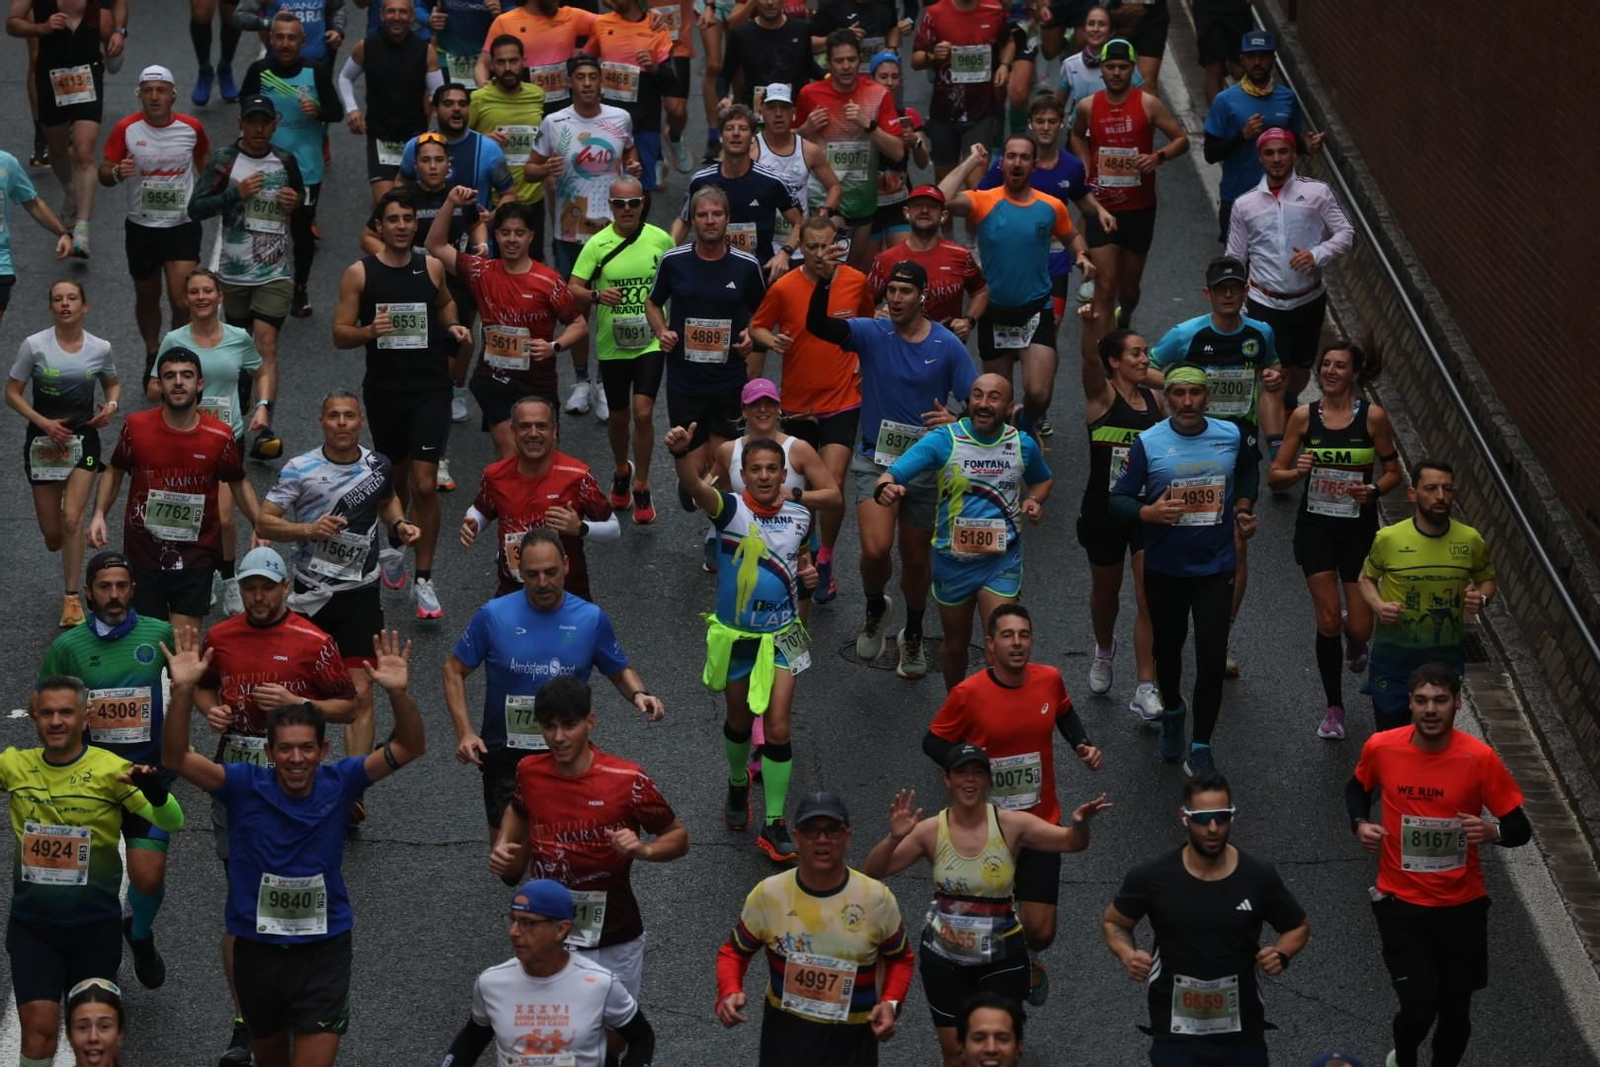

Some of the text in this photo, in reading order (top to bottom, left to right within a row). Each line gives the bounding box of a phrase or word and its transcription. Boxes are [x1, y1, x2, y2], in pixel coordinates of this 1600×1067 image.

[834, 152, 859, 164] 6907
[1104, 158, 1131, 171] 4845
[147, 192, 177, 204] 9554
[616, 327, 646, 340] 7091
[690, 329, 721, 345] 4889
[491, 335, 518, 351] 5611
[1211, 382, 1244, 396] 7300
[1312, 450, 1353, 464] ASM
[963, 460, 1012, 473] FONTANA
[1181, 490, 1214, 505] 4939
[156, 503, 191, 520] 7762
[753, 513, 795, 525] FNTANA
[959, 530, 994, 546] 5180
[321, 539, 363, 561] 15647
[750, 610, 791, 627] LAB
[97, 703, 138, 719] 4308
[1397, 785, 1444, 798] WE RUN
[1411, 832, 1453, 847] 8167
[31, 839, 73, 858] 4924
[269, 891, 311, 909] 9840
[795, 968, 839, 991] 4997
